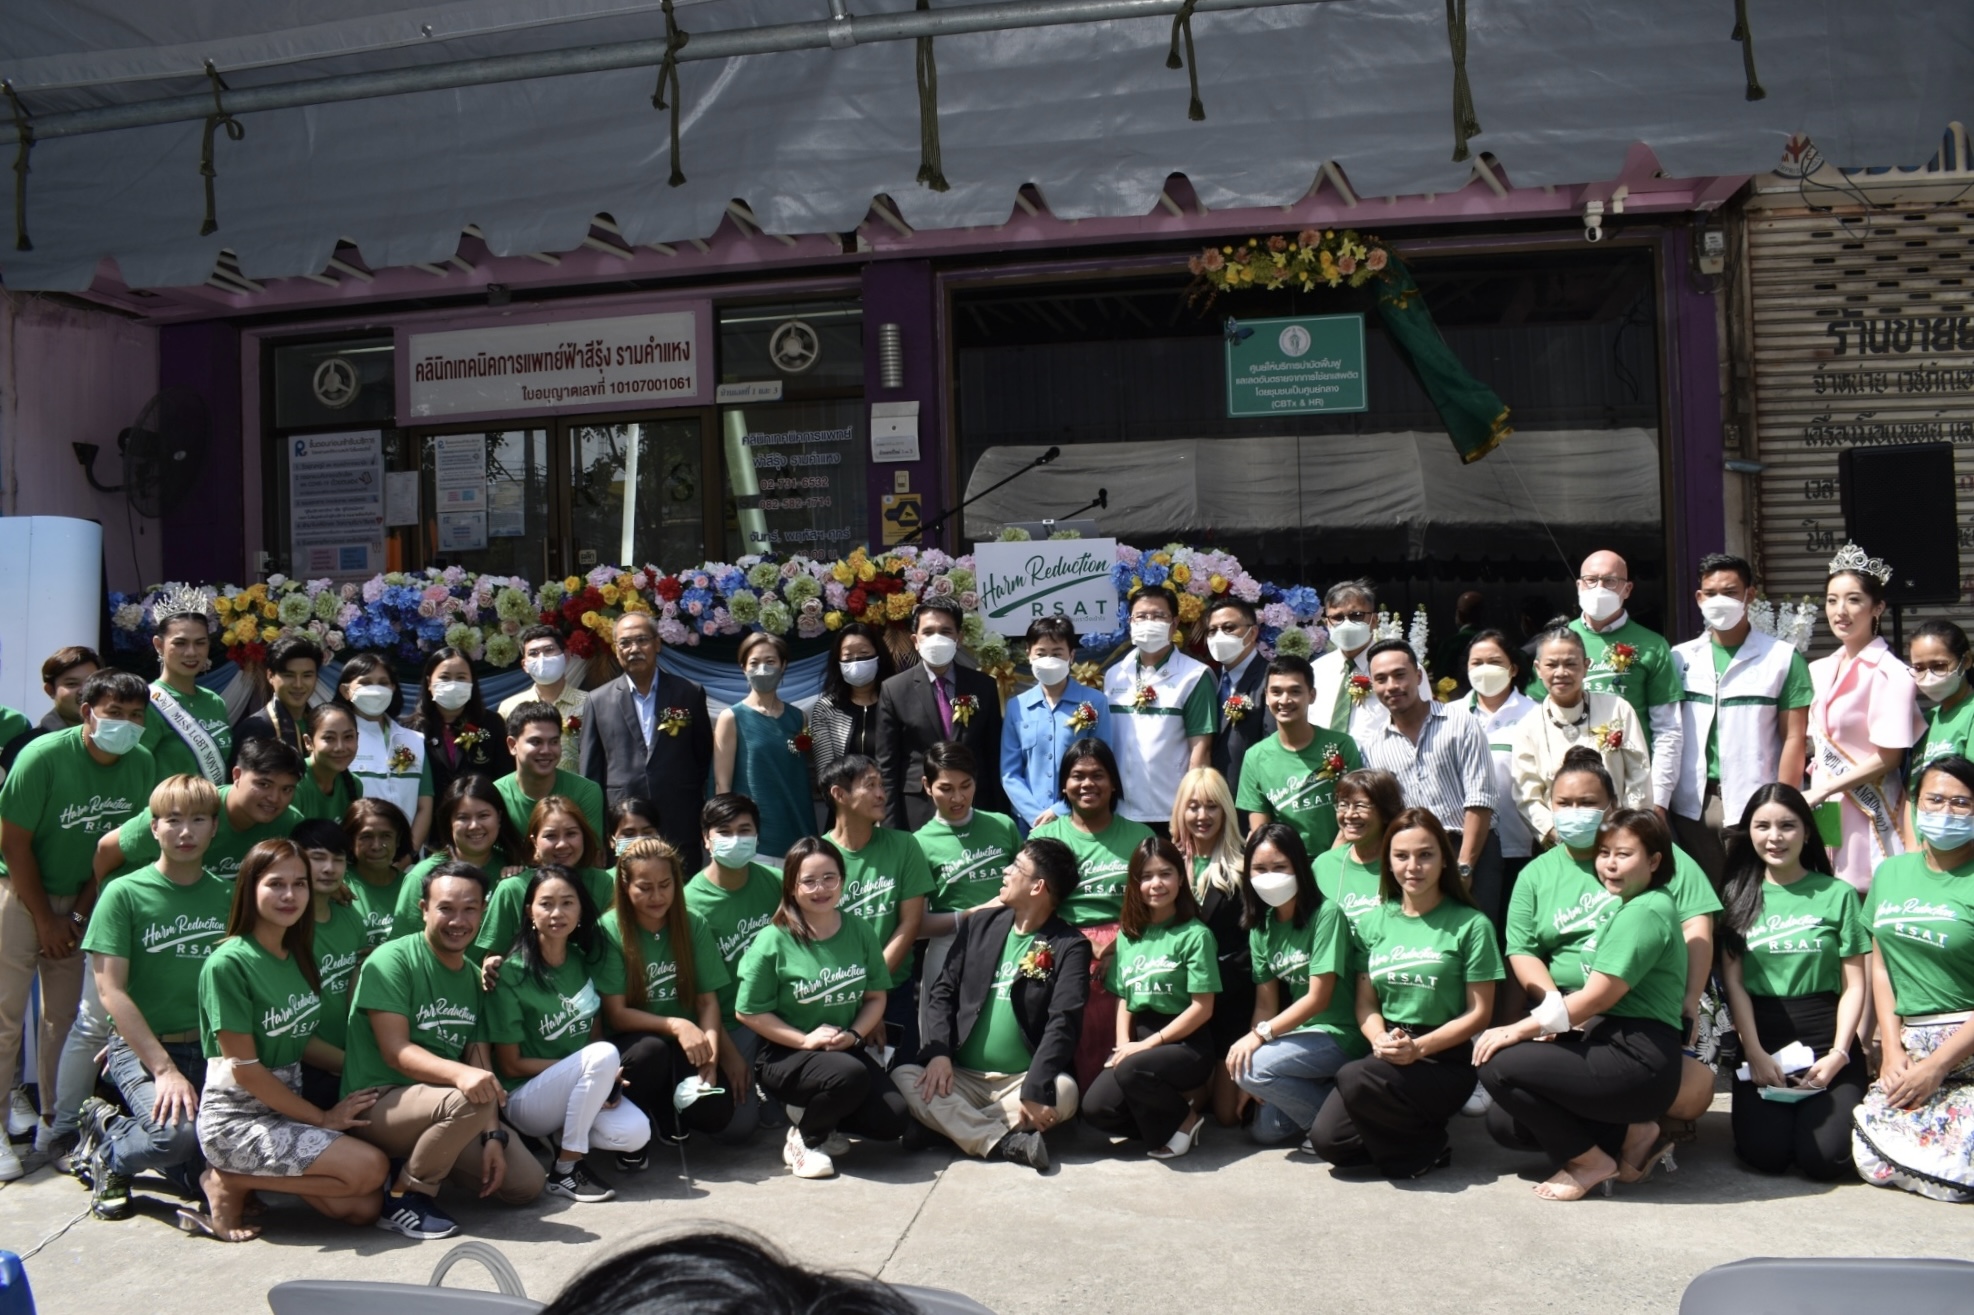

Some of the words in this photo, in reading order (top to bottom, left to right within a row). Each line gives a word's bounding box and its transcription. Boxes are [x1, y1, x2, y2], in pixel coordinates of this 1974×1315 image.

[1827, 308, 1974, 355] ร้านขายย
[415, 339, 612, 382] คลินิกเทคนิคการแพทย์ฟ้าสีรุ้ง
[616, 335, 691, 368] รามคำแหง
[1898, 361, 1974, 393] เวชภัณฑ
[522, 381, 606, 402] ใบอนุญาตเลขที่
[610, 376, 692, 395] 10107001061
[1271, 399, 1297, 409] (CBTx
[1308, 398, 1324, 407] HR)
[742, 425, 853, 446] คลินิกเทคนิคการแพทย์
[1949, 422, 1974, 444] แล
[790, 451, 841, 467] รามคำแหง
[760, 476, 829, 491] 02-731-6532
[759, 496, 831, 510] 082-582-1714
[980, 573, 1027, 609] Harm
[1025, 552, 1111, 587] Reduction
[171, 711, 191, 731] MISS
[188, 729, 209, 751] LGBT
[203, 750, 224, 785] NONTHA
[60, 804, 89, 823] Harm
[89, 795, 133, 814] Reduction
[1292, 793, 1332, 809] RSAT
[1852, 784, 1880, 813] ANGKOK
[962, 845, 1004, 865] Reduction
[849, 875, 896, 900] Reduction
[142, 923, 176, 947] Harm
[175, 914, 225, 934] Reduction
[1895, 923, 1948, 944] RSAT
[176, 943, 212, 955] RSA
[1389, 945, 1443, 963] Reduction
[1769, 938, 1823, 950] RSAT
[820, 964, 866, 987] Reduction
[1387, 971, 1438, 987] RSAT
[647, 987, 677, 998] RSA
[261, 1007, 293, 1030] Harm
[435, 997, 477, 1022] Reduction
[538, 1011, 566, 1036] Harm
